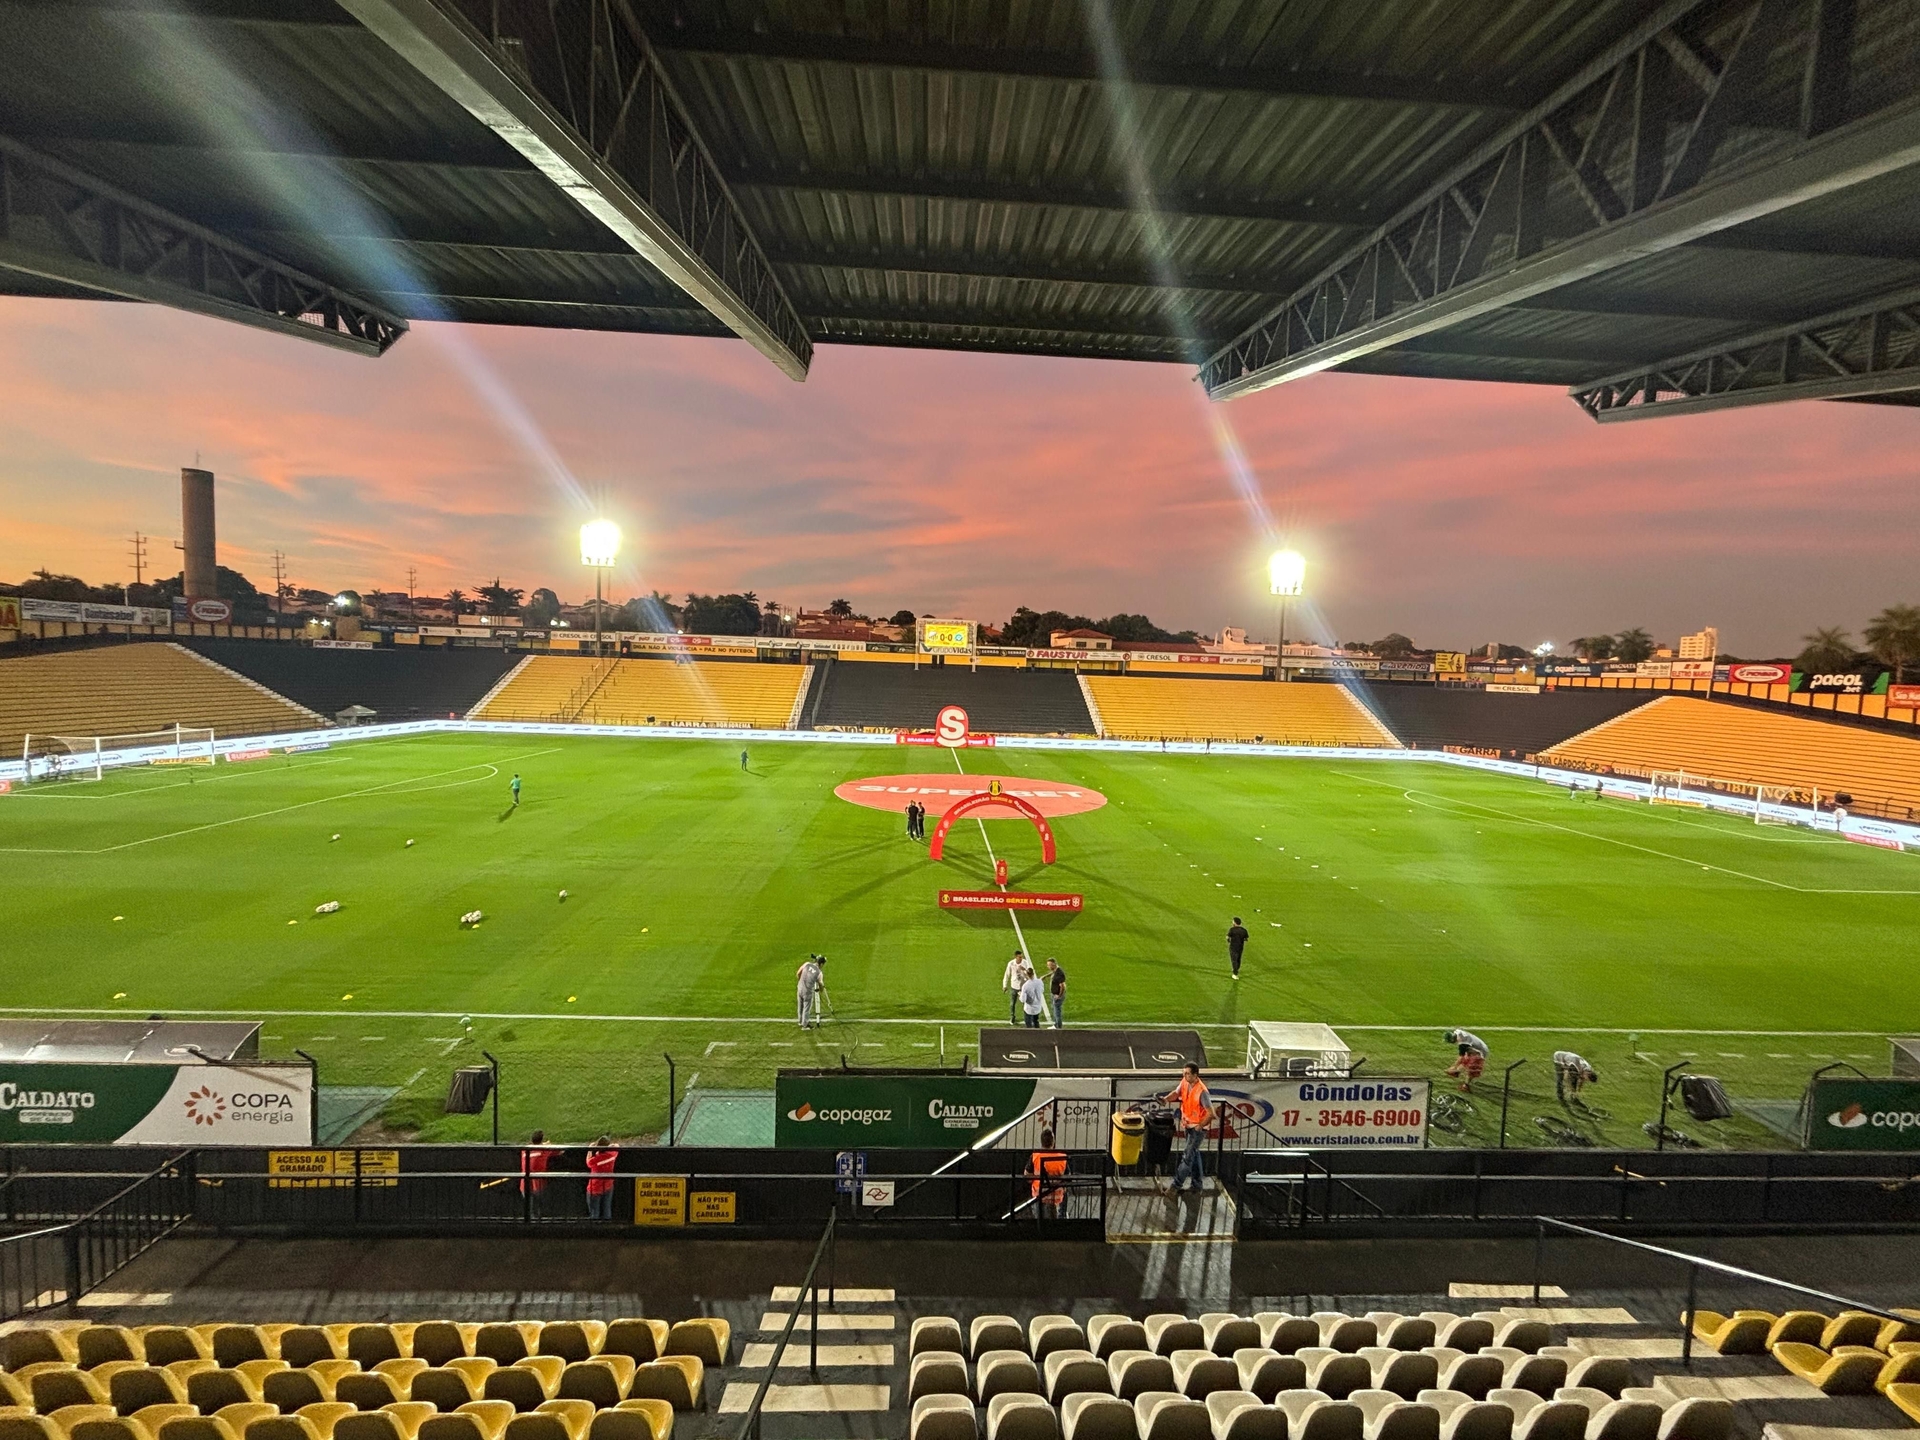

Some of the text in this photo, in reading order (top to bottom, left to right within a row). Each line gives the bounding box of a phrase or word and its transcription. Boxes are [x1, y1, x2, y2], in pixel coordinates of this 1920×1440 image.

[1036, 651, 1089, 659] FAUSTUR
[1459, 747, 1497, 757] GARRA
[952, 895, 1004, 904] BRASILEIRÃO
[1005, 896, 1029, 904] SÉRIE
[1035, 898, 1071, 907] SUPERBET
[1300, 1084, 1412, 1102] Gôndolas
[231, 1092, 293, 1109] COPA
[928, 1099, 994, 1118] CALDATO
[1064, 1106, 1100, 1116] COPA
[231, 1110, 294, 1125] energia
[819, 1108, 892, 1125] copagaz
[1064, 1115, 1100, 1127] energia
[1282, 1110, 1300, 1127] 17
[1319, 1109, 1421, 1127] 3546-6900
[1281, 1134, 1420, 1146] www.cristalaco.com.br
[276, 1155, 327, 1164] ACESSO AO
[279, 1164, 324, 1173] GRAMADO
[654, 1181, 678, 1189] SOMENTE
